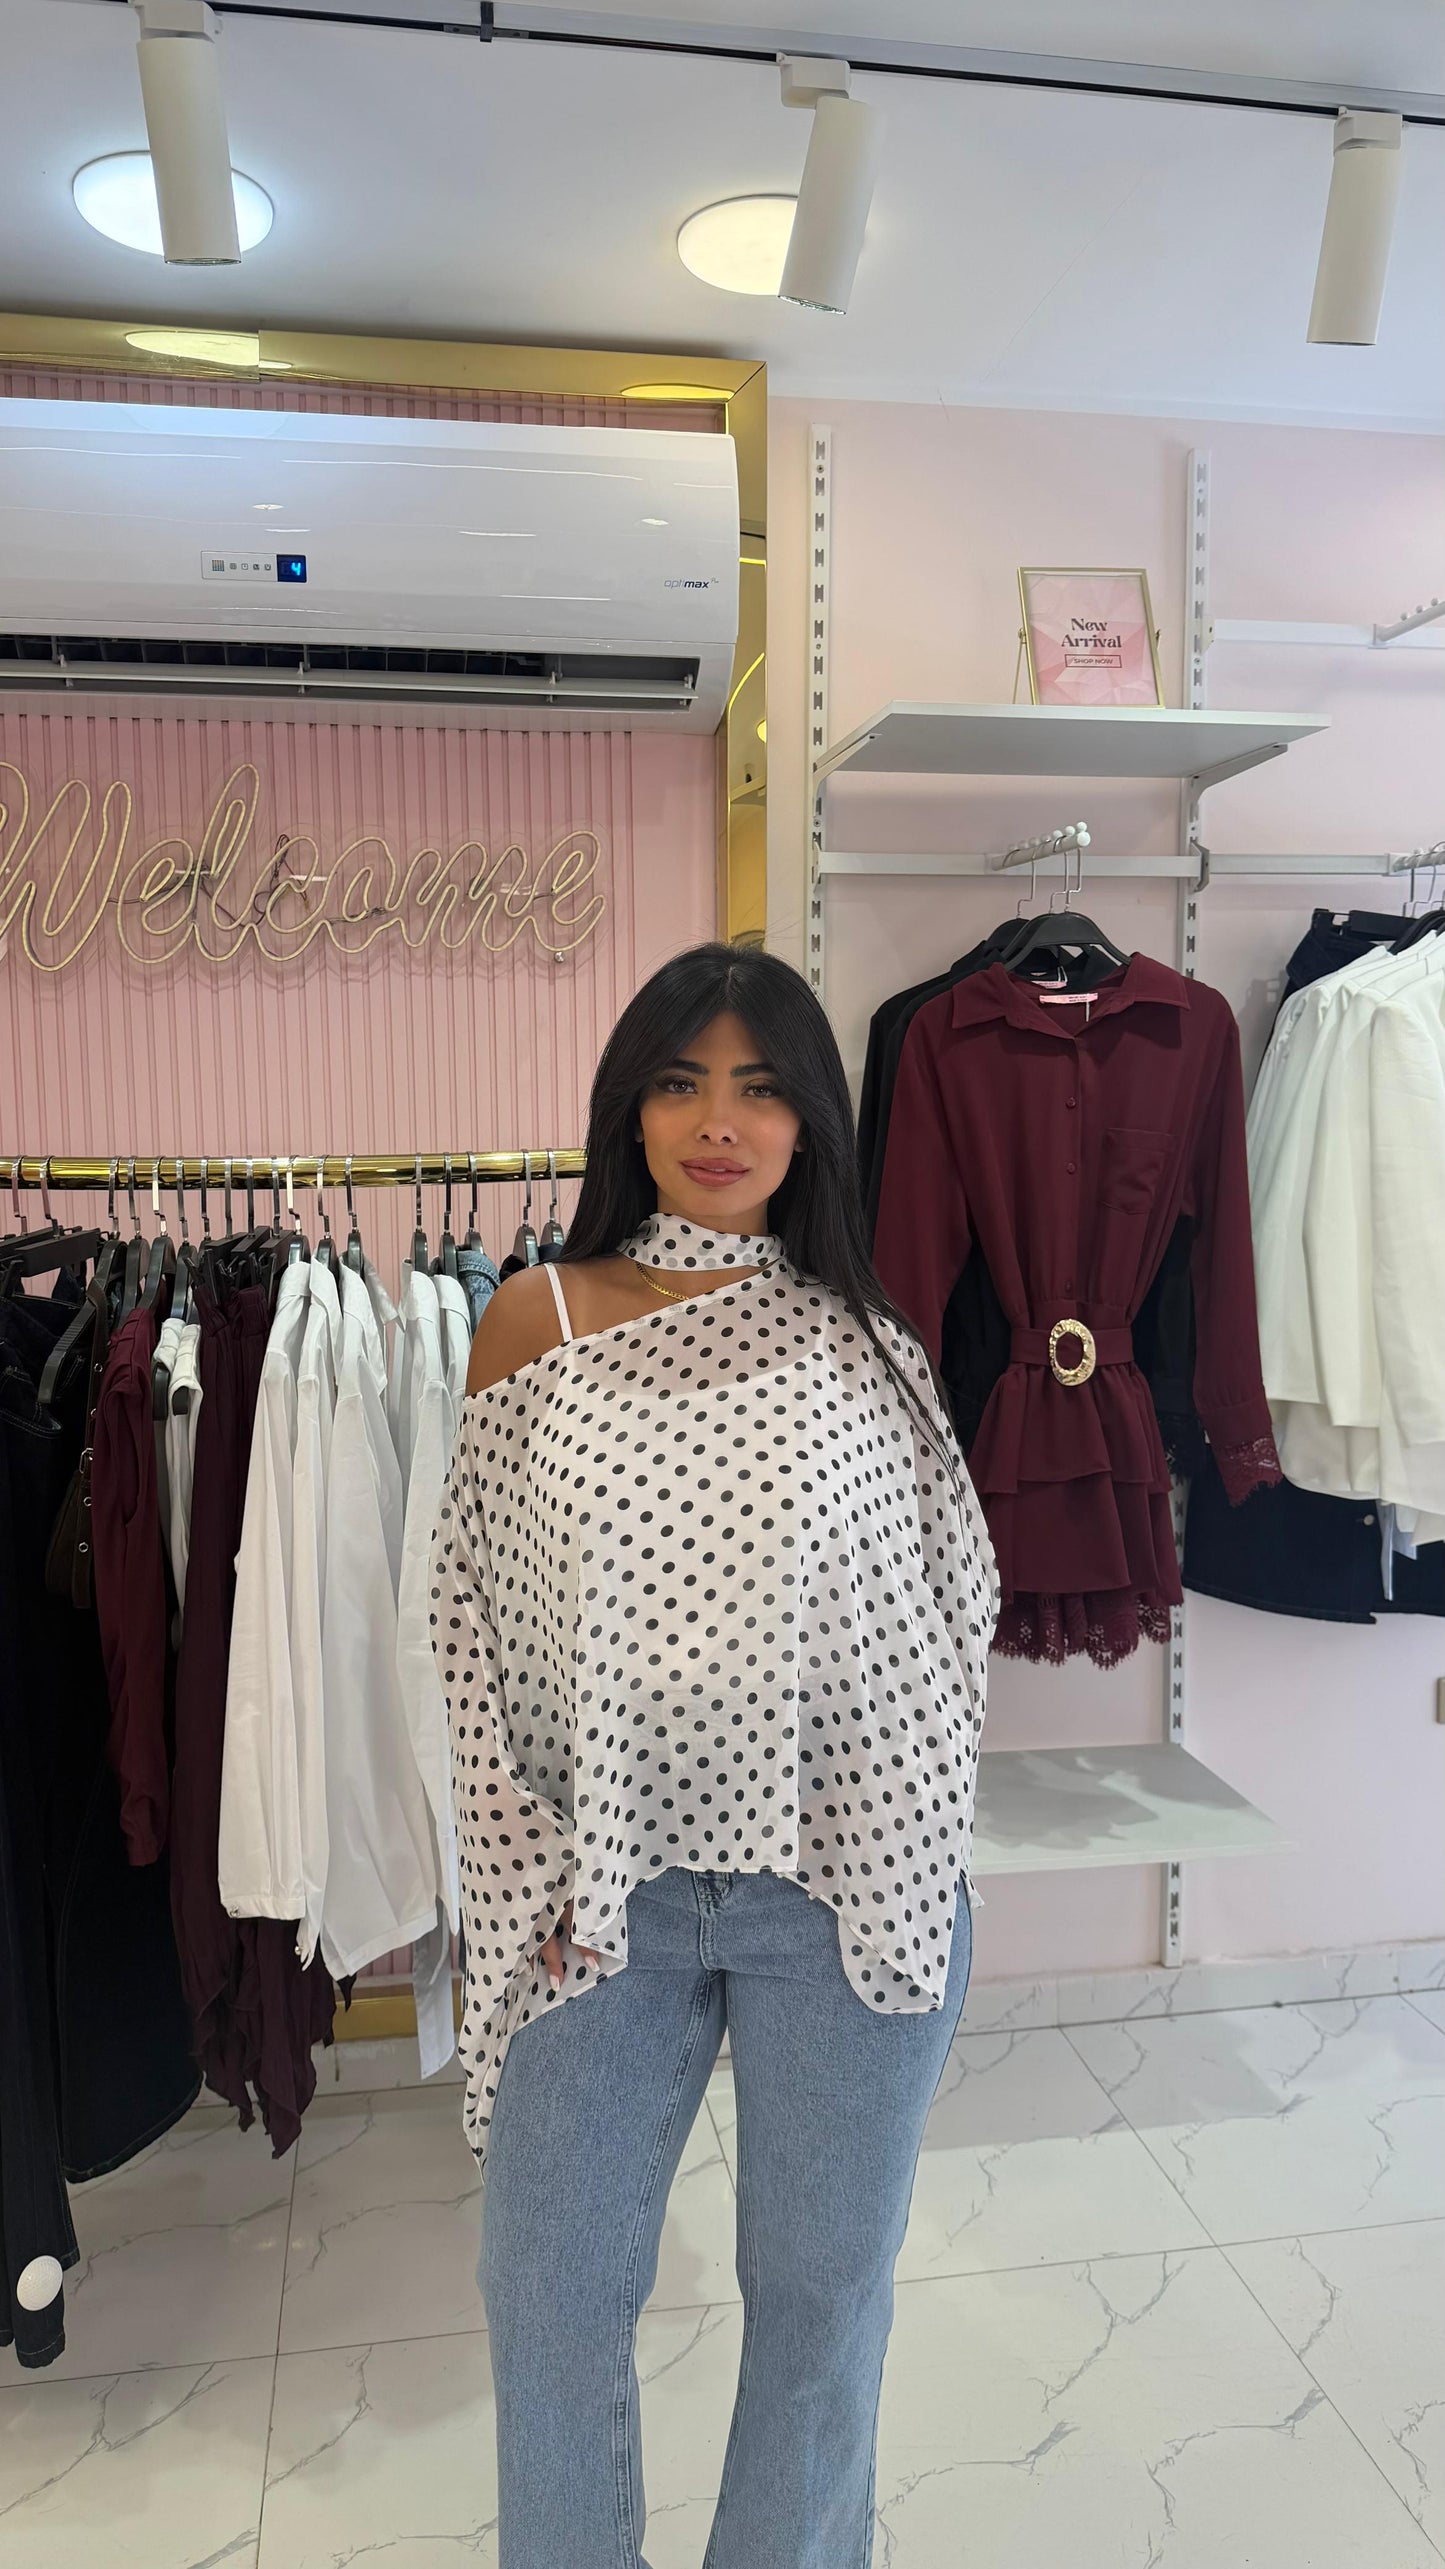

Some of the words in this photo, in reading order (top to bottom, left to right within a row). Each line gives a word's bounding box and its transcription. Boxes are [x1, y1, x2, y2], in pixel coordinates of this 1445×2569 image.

[291, 562, 302, 576] 4
[1071, 618, 1108, 631] New
[1061, 634, 1122, 648] Arrival
[0, 761, 606, 972] Welcome
